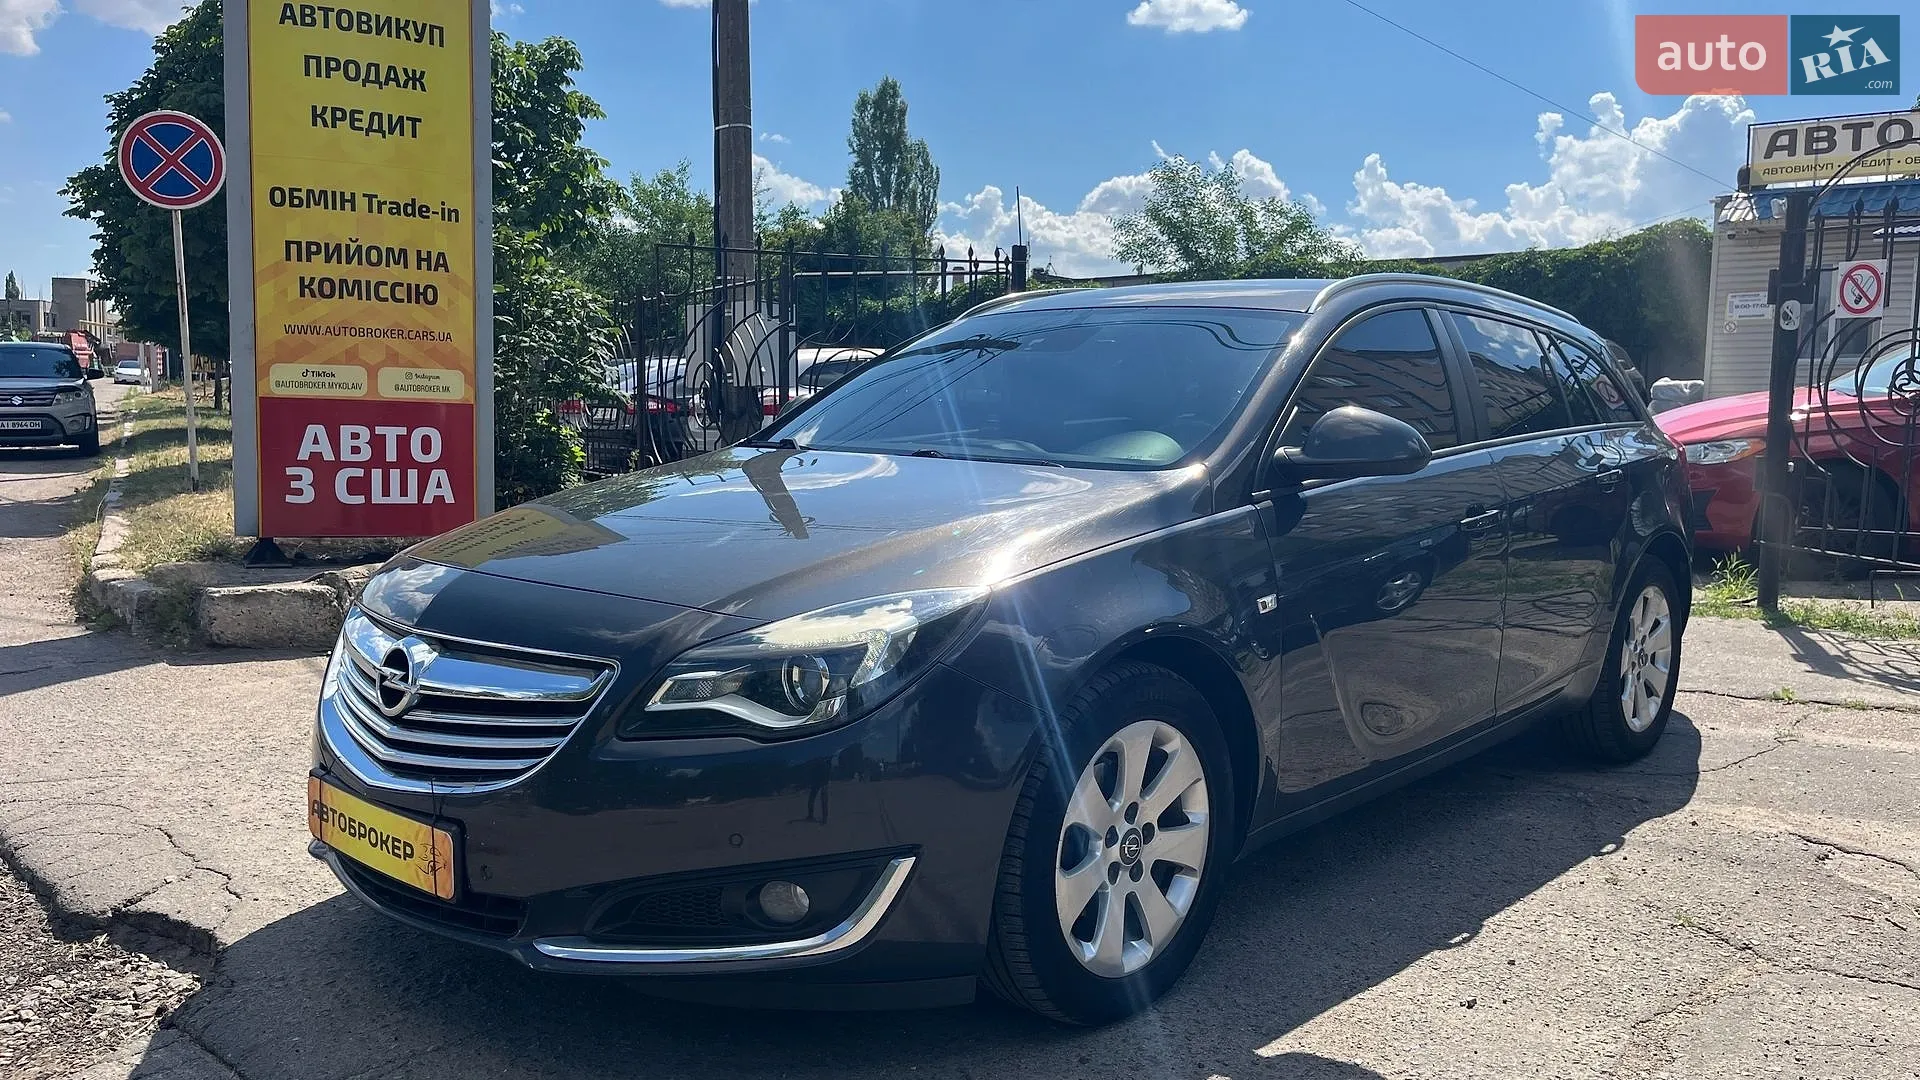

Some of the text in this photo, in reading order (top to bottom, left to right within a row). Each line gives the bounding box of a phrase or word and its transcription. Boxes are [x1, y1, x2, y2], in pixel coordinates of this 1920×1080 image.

[279, 3, 445, 48] АВТОВИКУП
[304, 55, 427, 92] ПРОДАЖ
[311, 104, 422, 139] КРЕДИТ
[1762, 162, 1834, 176] АВТОВИКУП
[1845, 157, 1894, 169] ЕДИТ
[269, 186, 460, 223] ОБМІН Trade-in
[284, 237, 450, 273] ПРИЙОМ НА
[299, 276, 439, 306] КОМІССІЮ
[284, 324, 453, 343] WWW.AUTOBROKER.CARS.UA
[275, 379, 451, 394] @AUTOBROKER.MYKOLAIV @AUTOBROKER.MK
[310, 370, 336, 379] TikTok
[297, 424, 442, 464] АВТО
[334, 467, 456, 505] США
[311, 799, 415, 861] АВТОБРОКЕР
